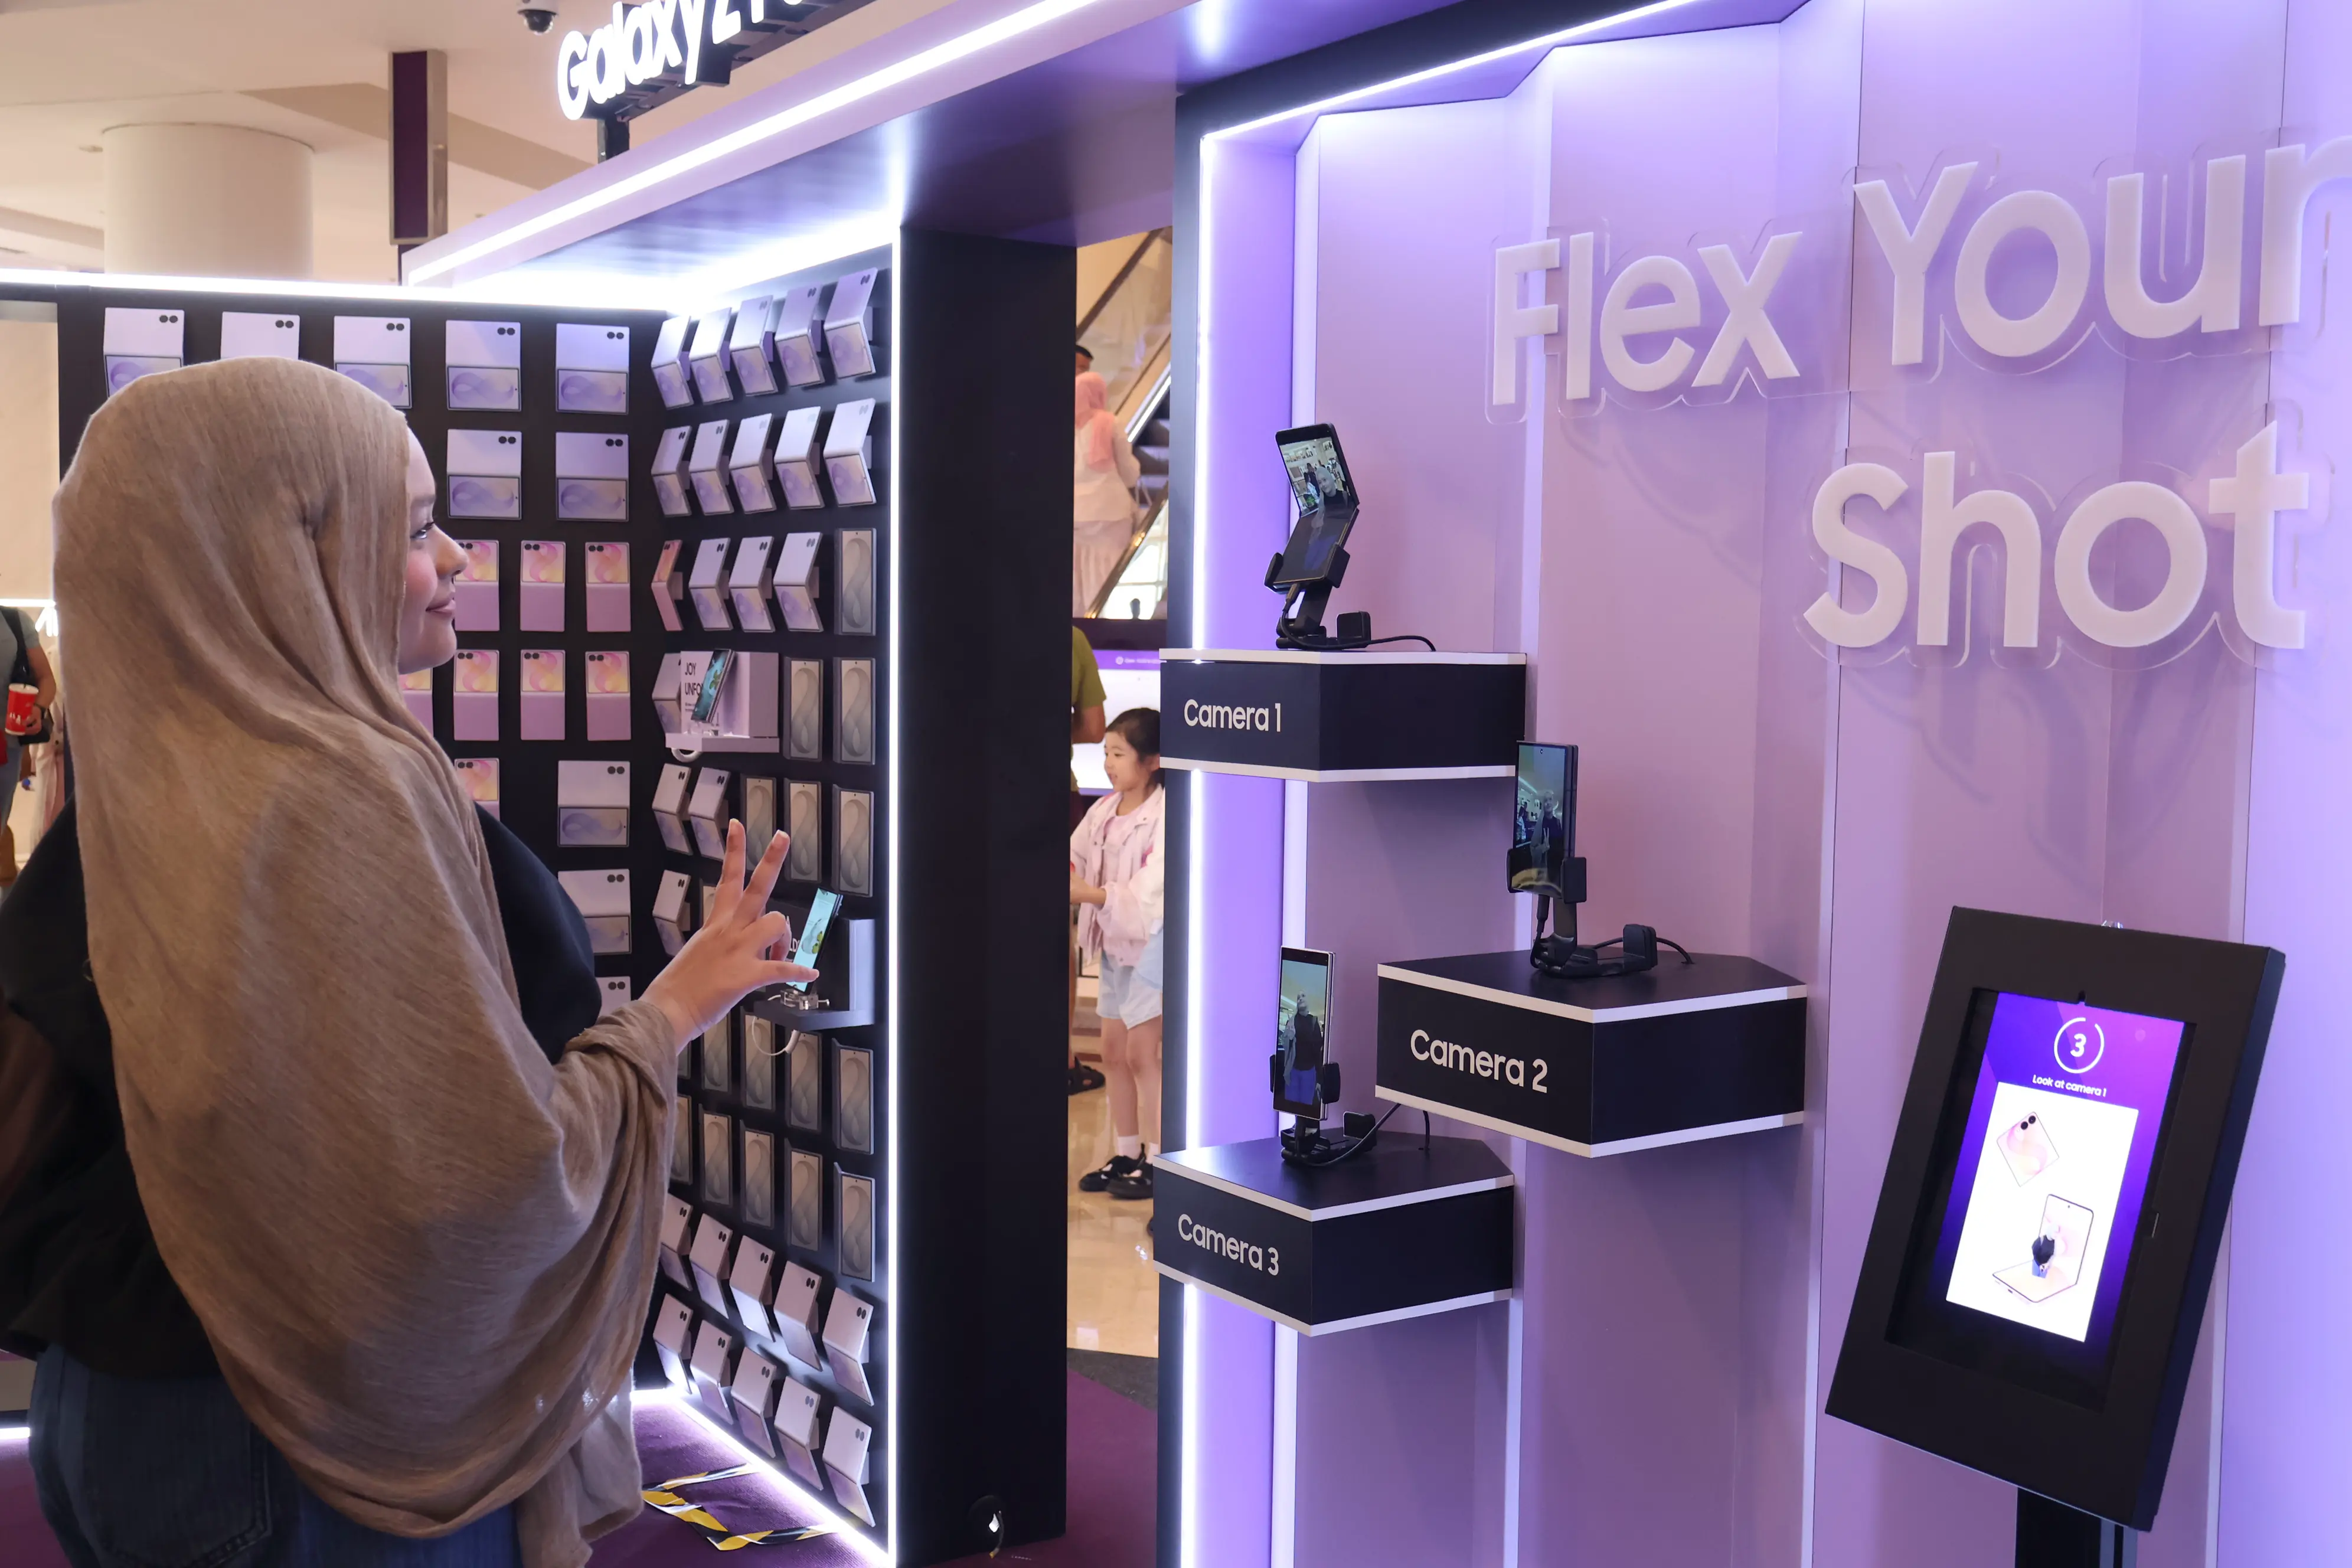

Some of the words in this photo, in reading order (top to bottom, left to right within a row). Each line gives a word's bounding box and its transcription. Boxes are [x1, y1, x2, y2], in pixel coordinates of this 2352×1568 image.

[557, 0, 704, 120] Galaxy
[1492, 231, 1802, 405] Flex
[1853, 135, 2352, 365] Your
[1802, 420, 2309, 649] Shot
[685, 662, 696, 675] JOY
[685, 682, 704, 697] UNFO
[1184, 699, 1269, 731] Camera
[1275, 703, 1281, 732] 1
[1410, 1029, 1524, 1087] Camera
[1532, 1059, 1548, 1093] 2
[2070, 1033, 2087, 1057] 3
[2032, 1074, 2053, 1087] Look
[2054, 1079, 2065, 1089] at
[2065, 1082, 2102, 1096] camera
[1178, 1213, 1263, 1271] Camera
[1268, 1247, 1279, 1276] 3
